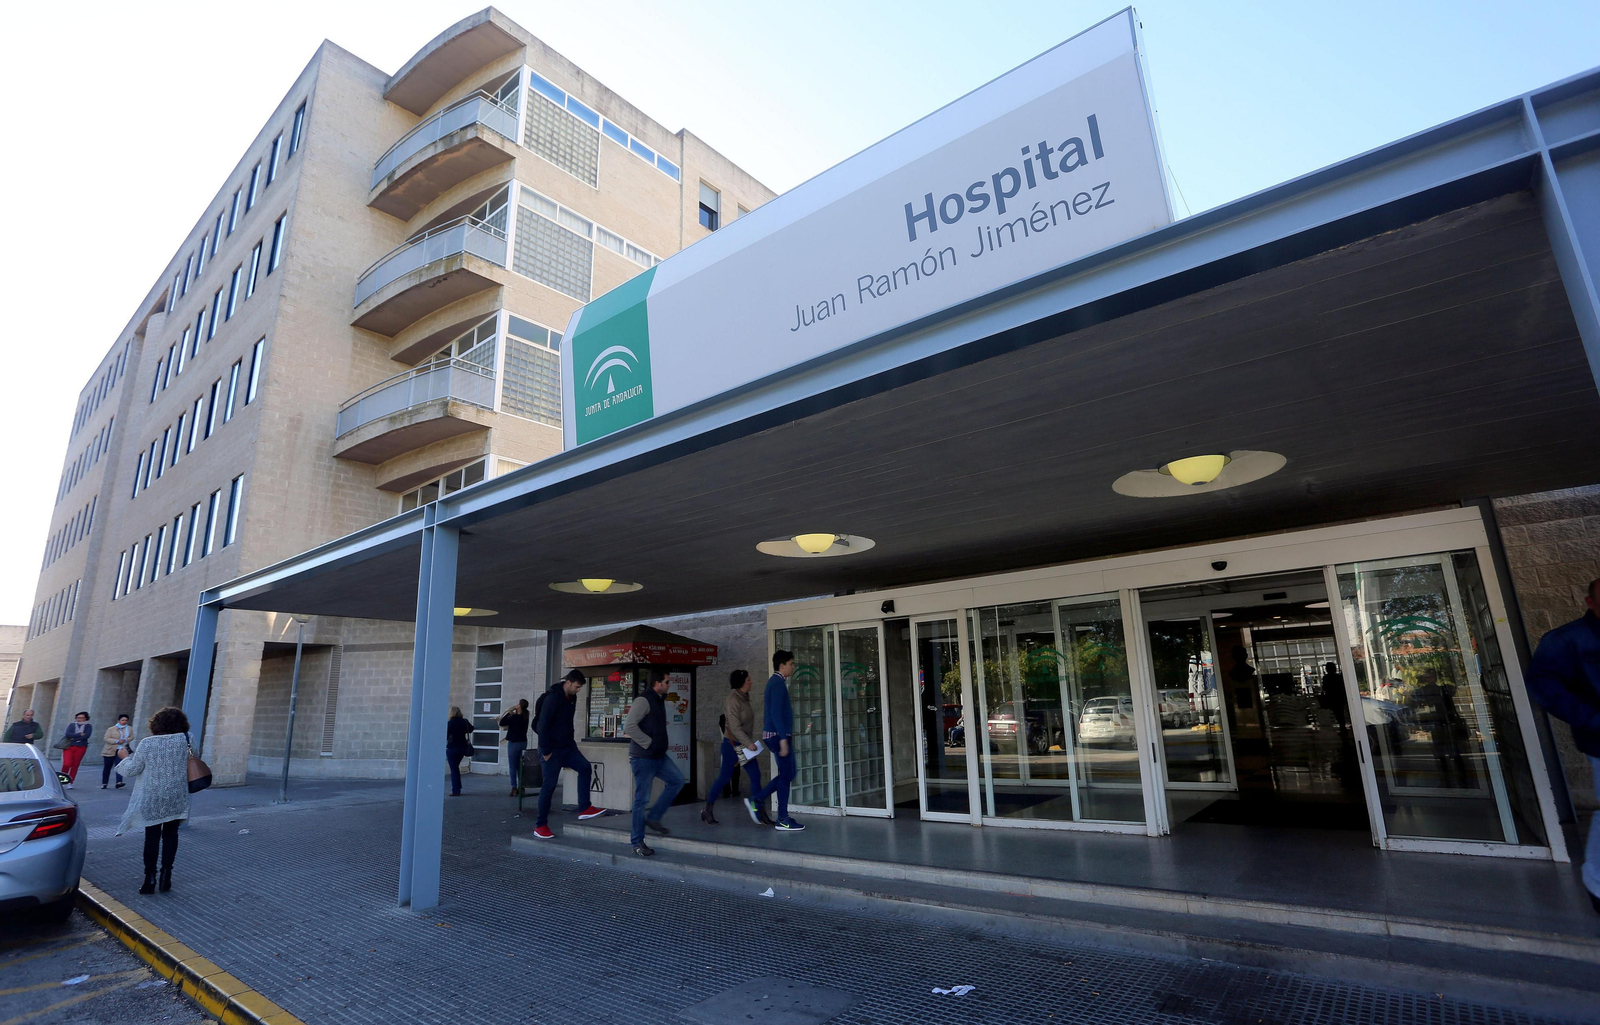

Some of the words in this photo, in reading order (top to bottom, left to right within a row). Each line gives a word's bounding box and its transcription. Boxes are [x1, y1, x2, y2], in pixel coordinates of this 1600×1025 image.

[904, 113, 1105, 242] Hospital
[790, 293, 846, 332] Juan
[856, 246, 957, 304] Ramón
[970, 181, 1115, 258] Jiménez
[585, 402, 601, 417] JUNTA
[603, 398, 610, 409] DE
[612, 384, 643, 405] ANDALUCIA
